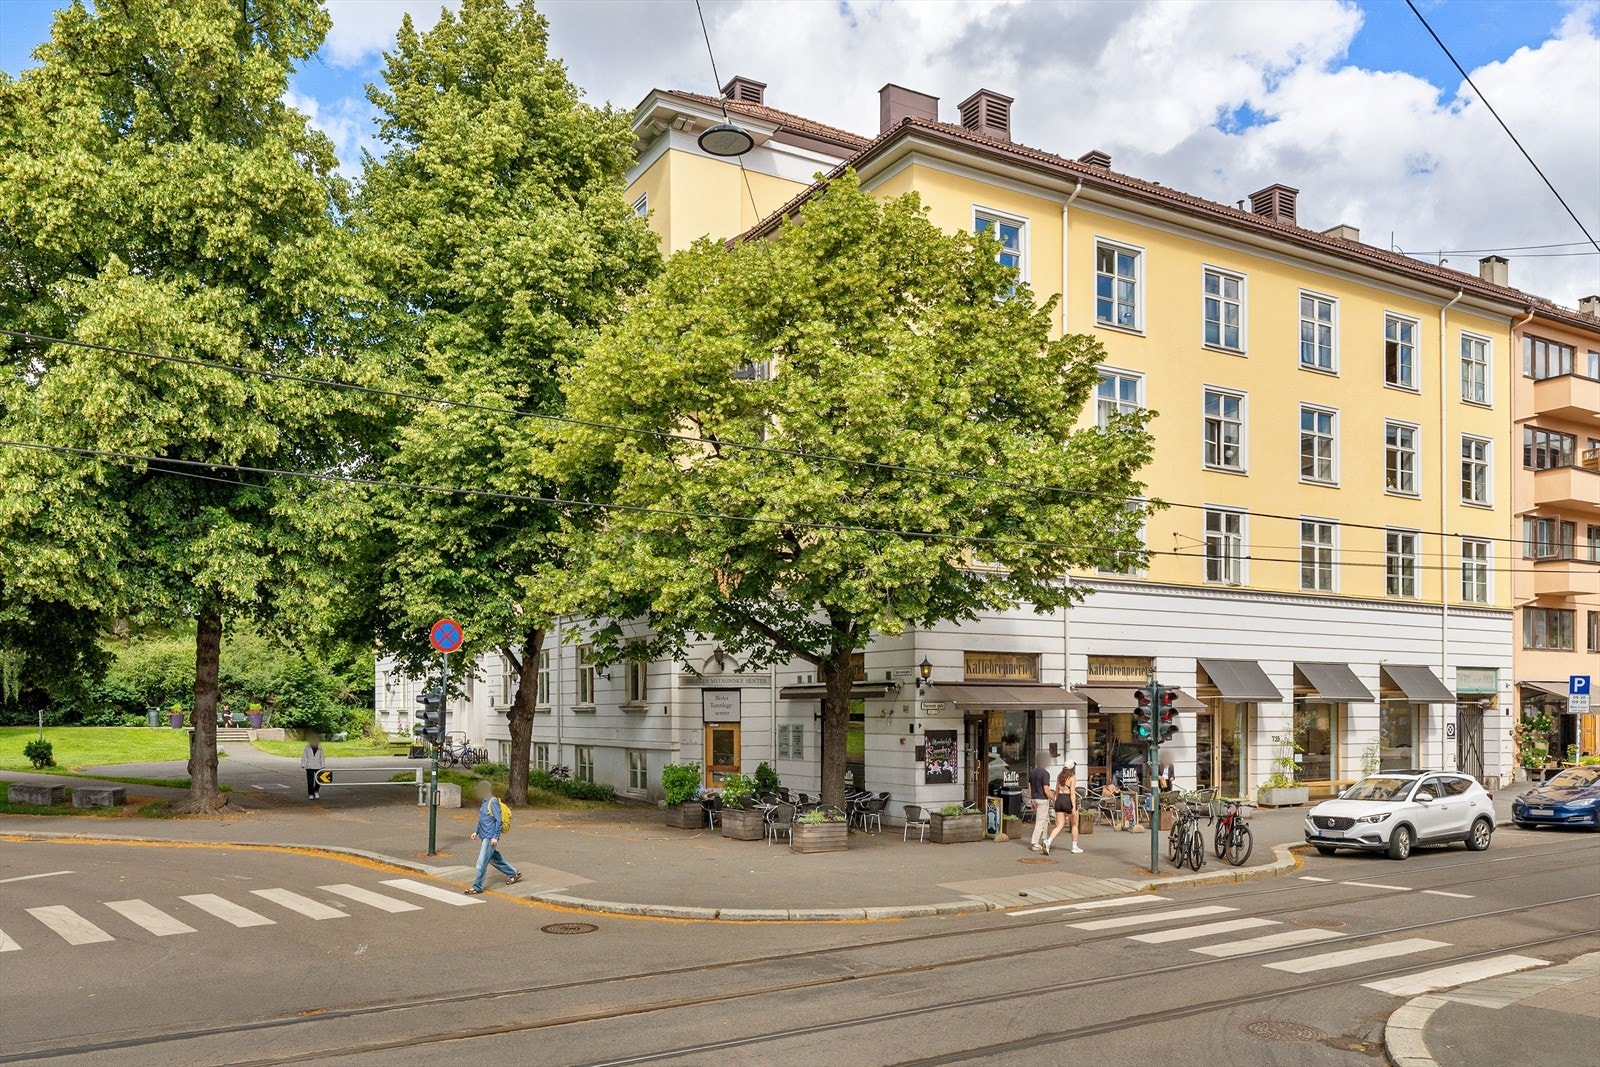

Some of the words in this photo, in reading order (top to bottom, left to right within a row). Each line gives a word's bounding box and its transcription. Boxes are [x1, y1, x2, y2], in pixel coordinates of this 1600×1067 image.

[1088, 662, 1148, 676] Kaffebrenneriet
[1574, 677, 1586, 693] P
[1003, 771, 1020, 782] Kaffe
[1122, 767, 1137, 778] Kaffe
